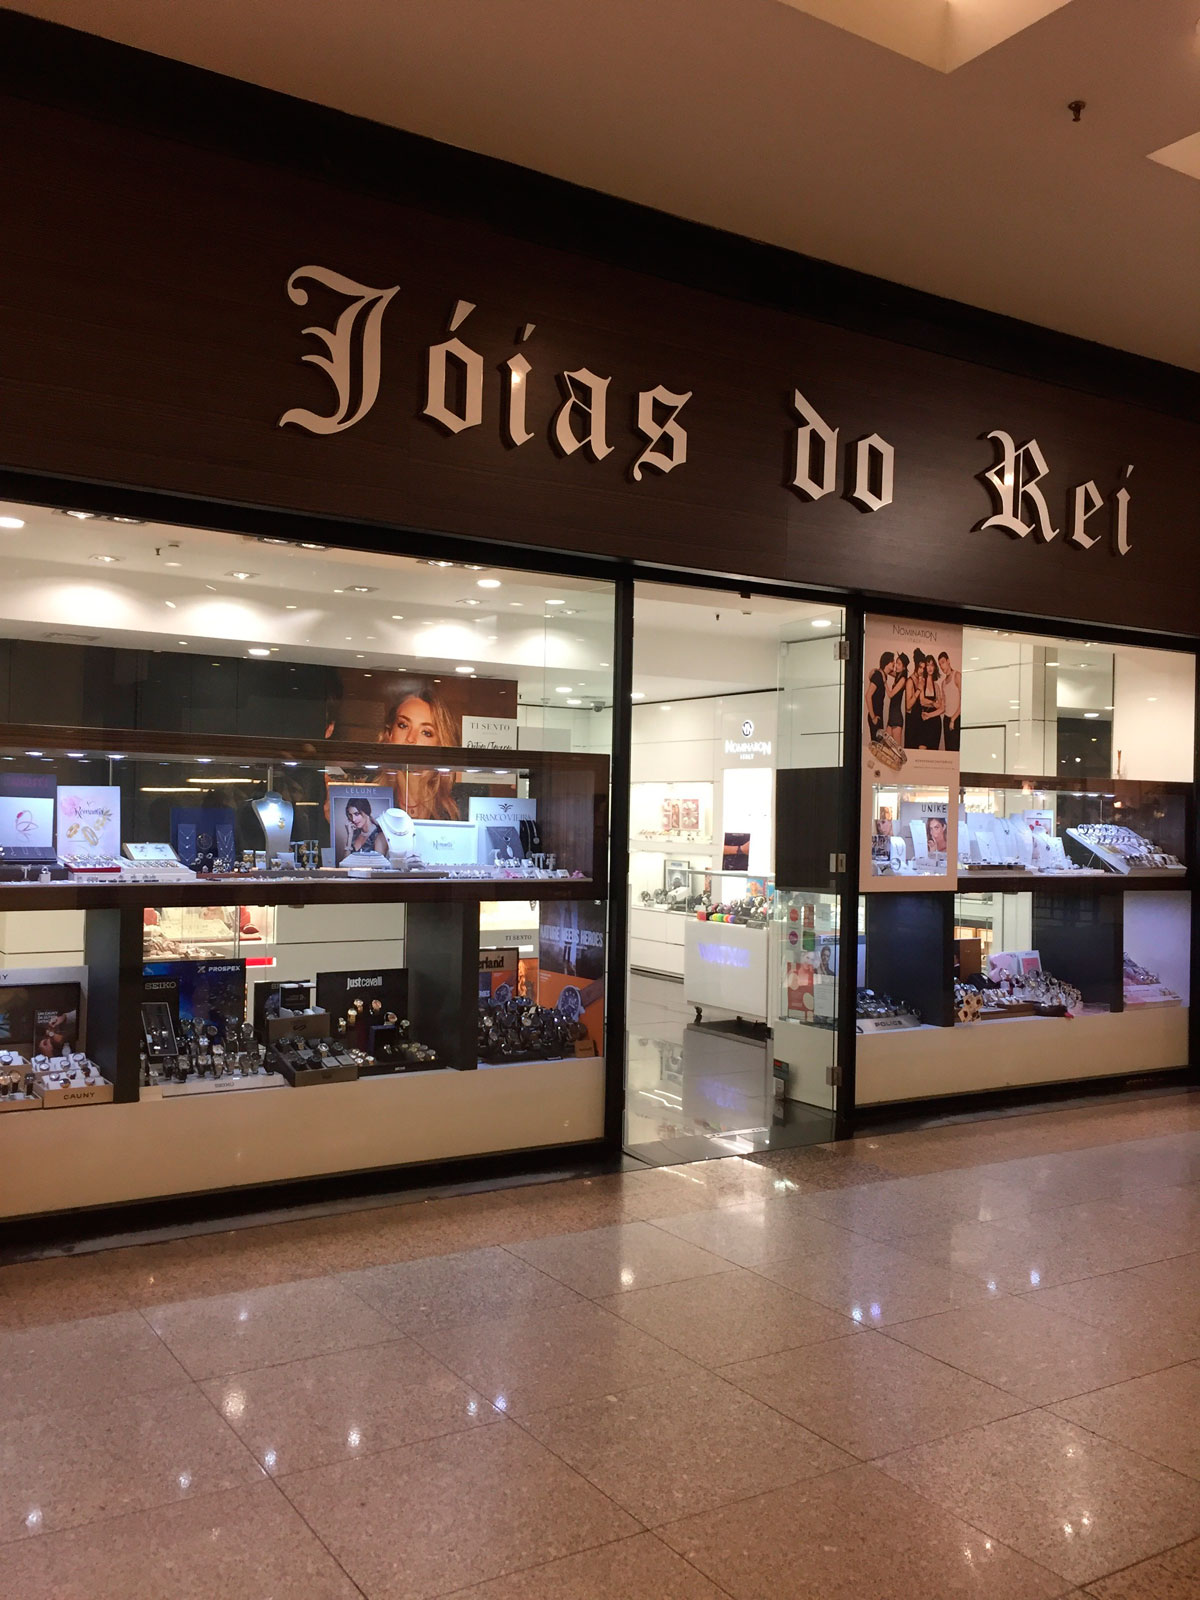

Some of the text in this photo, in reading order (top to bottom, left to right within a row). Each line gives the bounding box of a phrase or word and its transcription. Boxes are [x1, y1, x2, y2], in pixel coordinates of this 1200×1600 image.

[279, 265, 1135, 556] Jóias do Rei
[481, 723, 510, 731] SENTO
[921, 804, 947, 813] UNIKE
[144, 981, 177, 990] SEIKO
[63, 1091, 96, 1100] CAUNY
